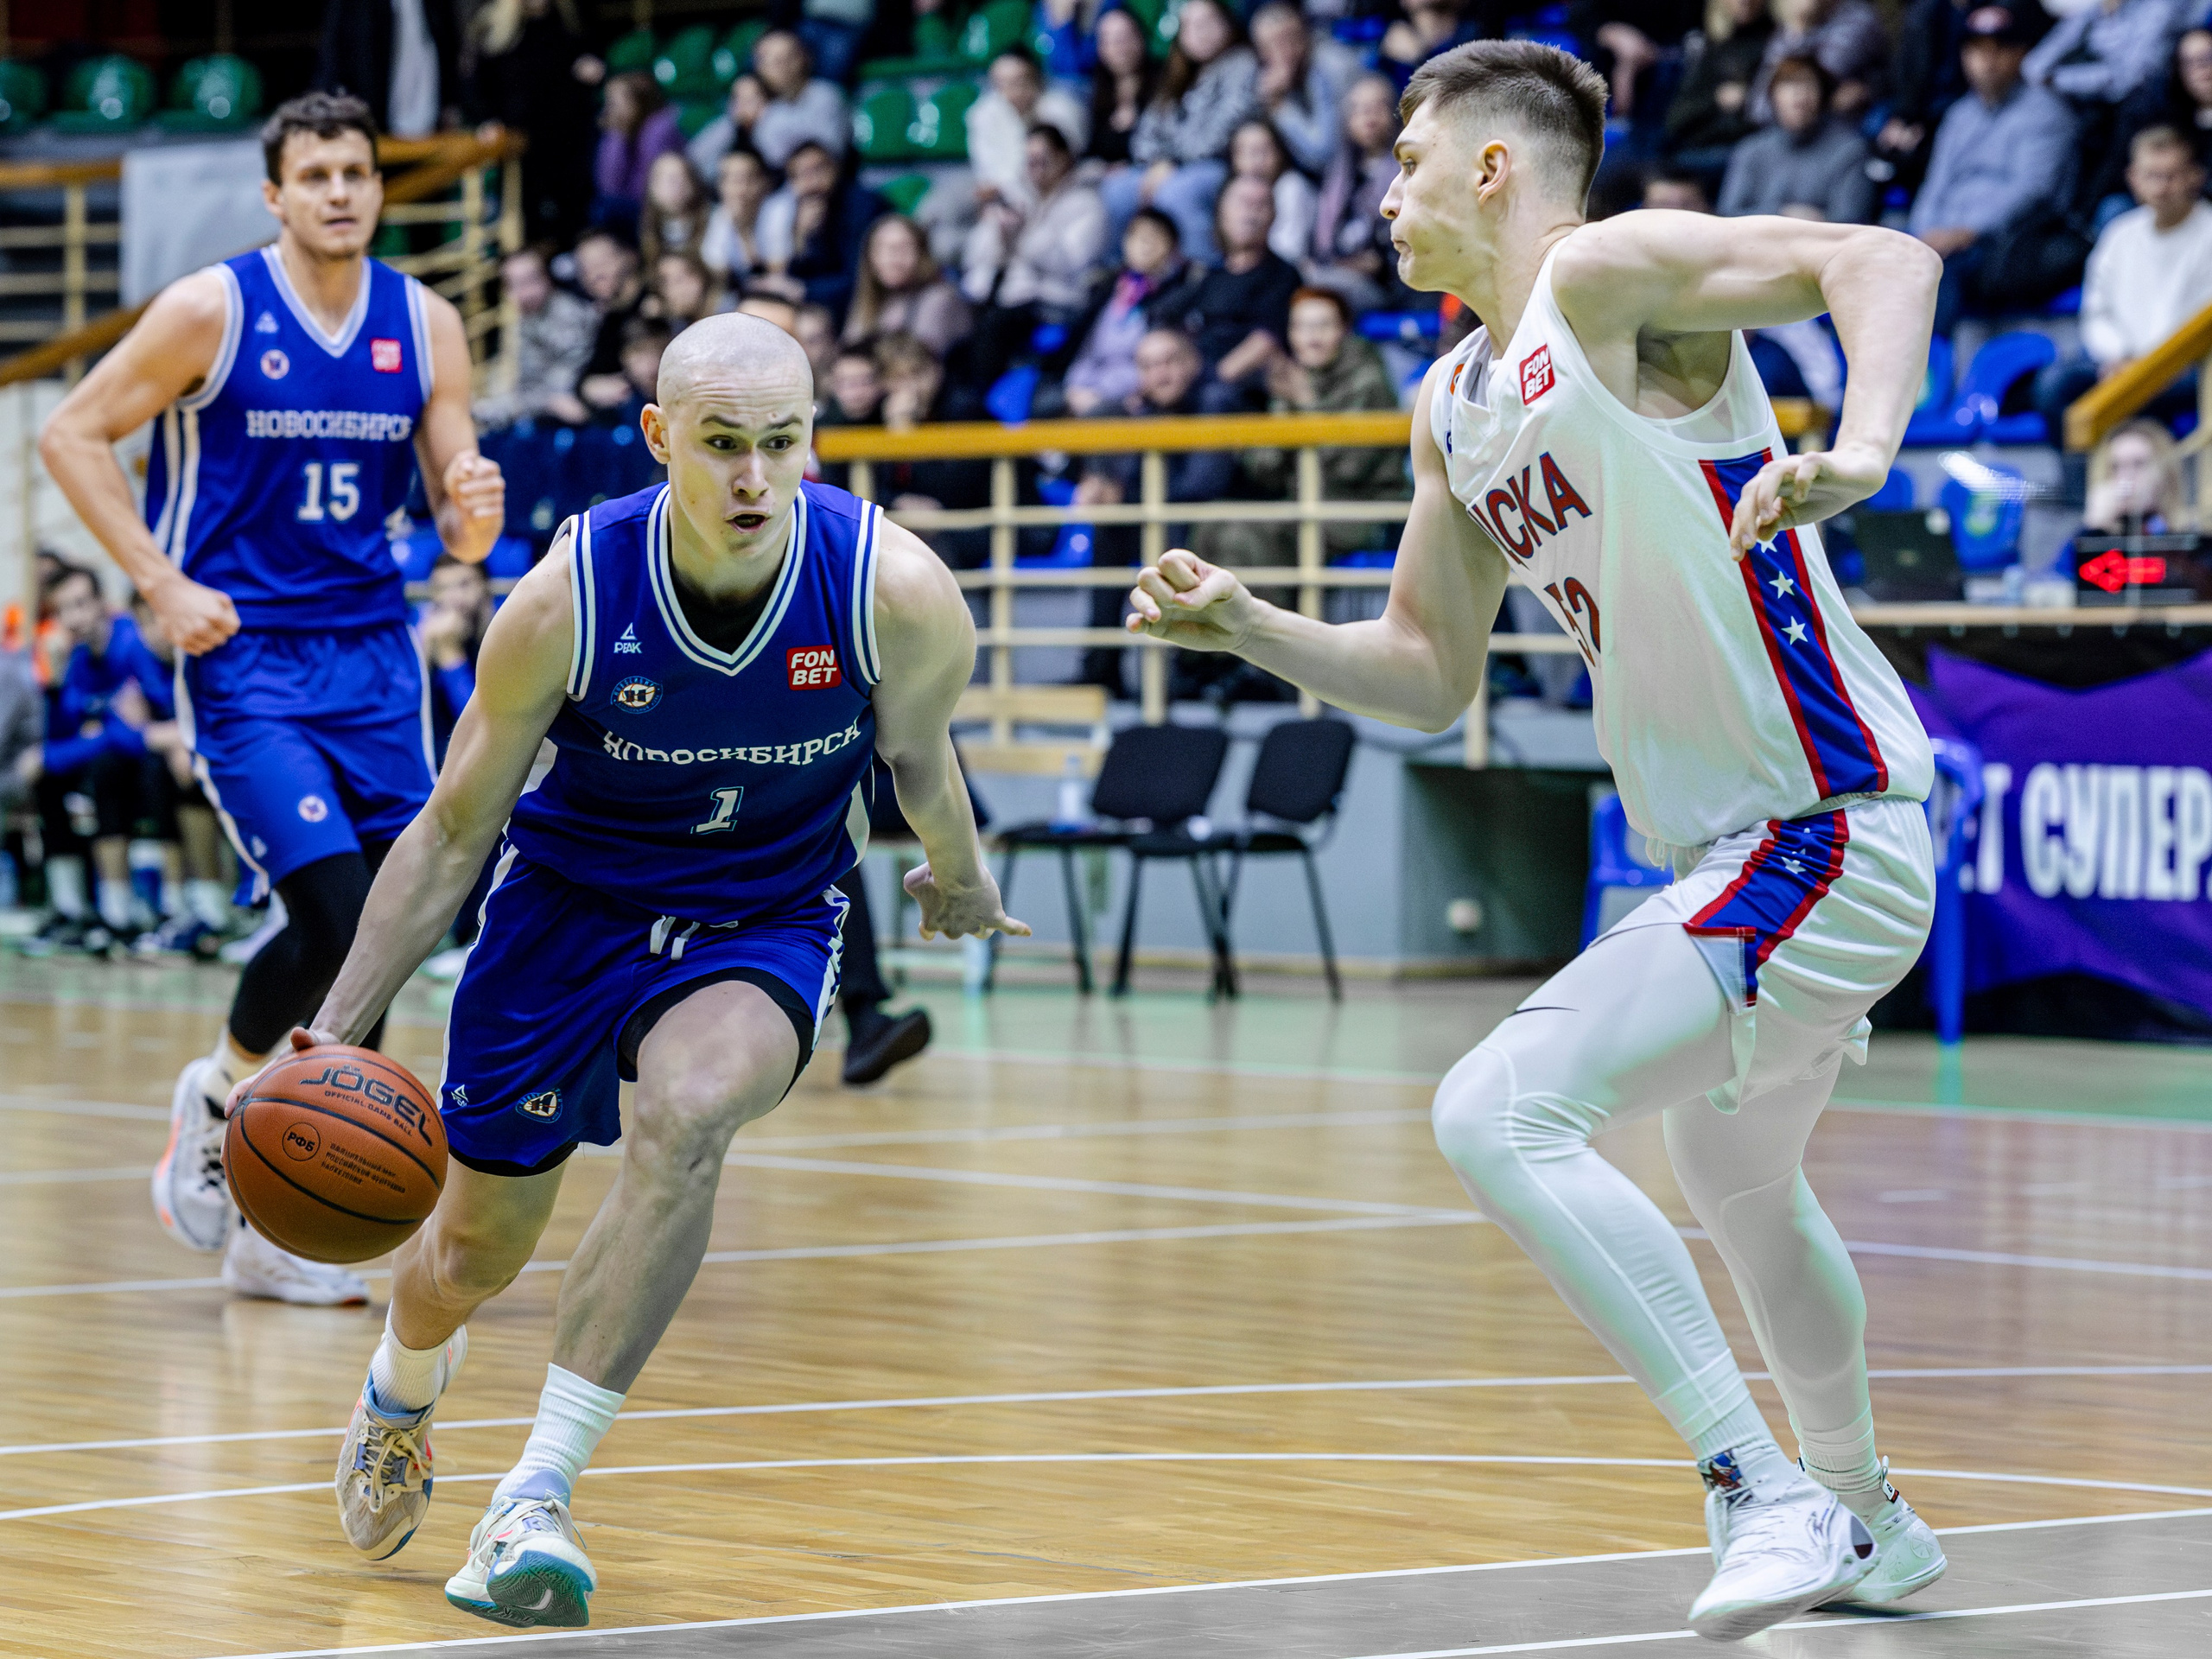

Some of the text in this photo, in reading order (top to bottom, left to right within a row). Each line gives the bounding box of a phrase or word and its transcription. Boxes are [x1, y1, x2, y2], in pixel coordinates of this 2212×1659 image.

[1523, 346, 1550, 382] FON
[1525, 363, 1552, 401] BET
[296, 461, 360, 522] 15
[613, 641, 643, 654] PEAK
[791, 649, 835, 669] FON
[792, 667, 837, 685] BET
[691, 787, 743, 834] 1
[2020, 761, 2212, 901] СУПЕР
[299, 1065, 432, 1147] JÖGEL
[324, 1090, 366, 1108] OFFICIAL
[393, 1118, 412, 1136] BALL
[287, 1131, 315, 1152] РФБ
